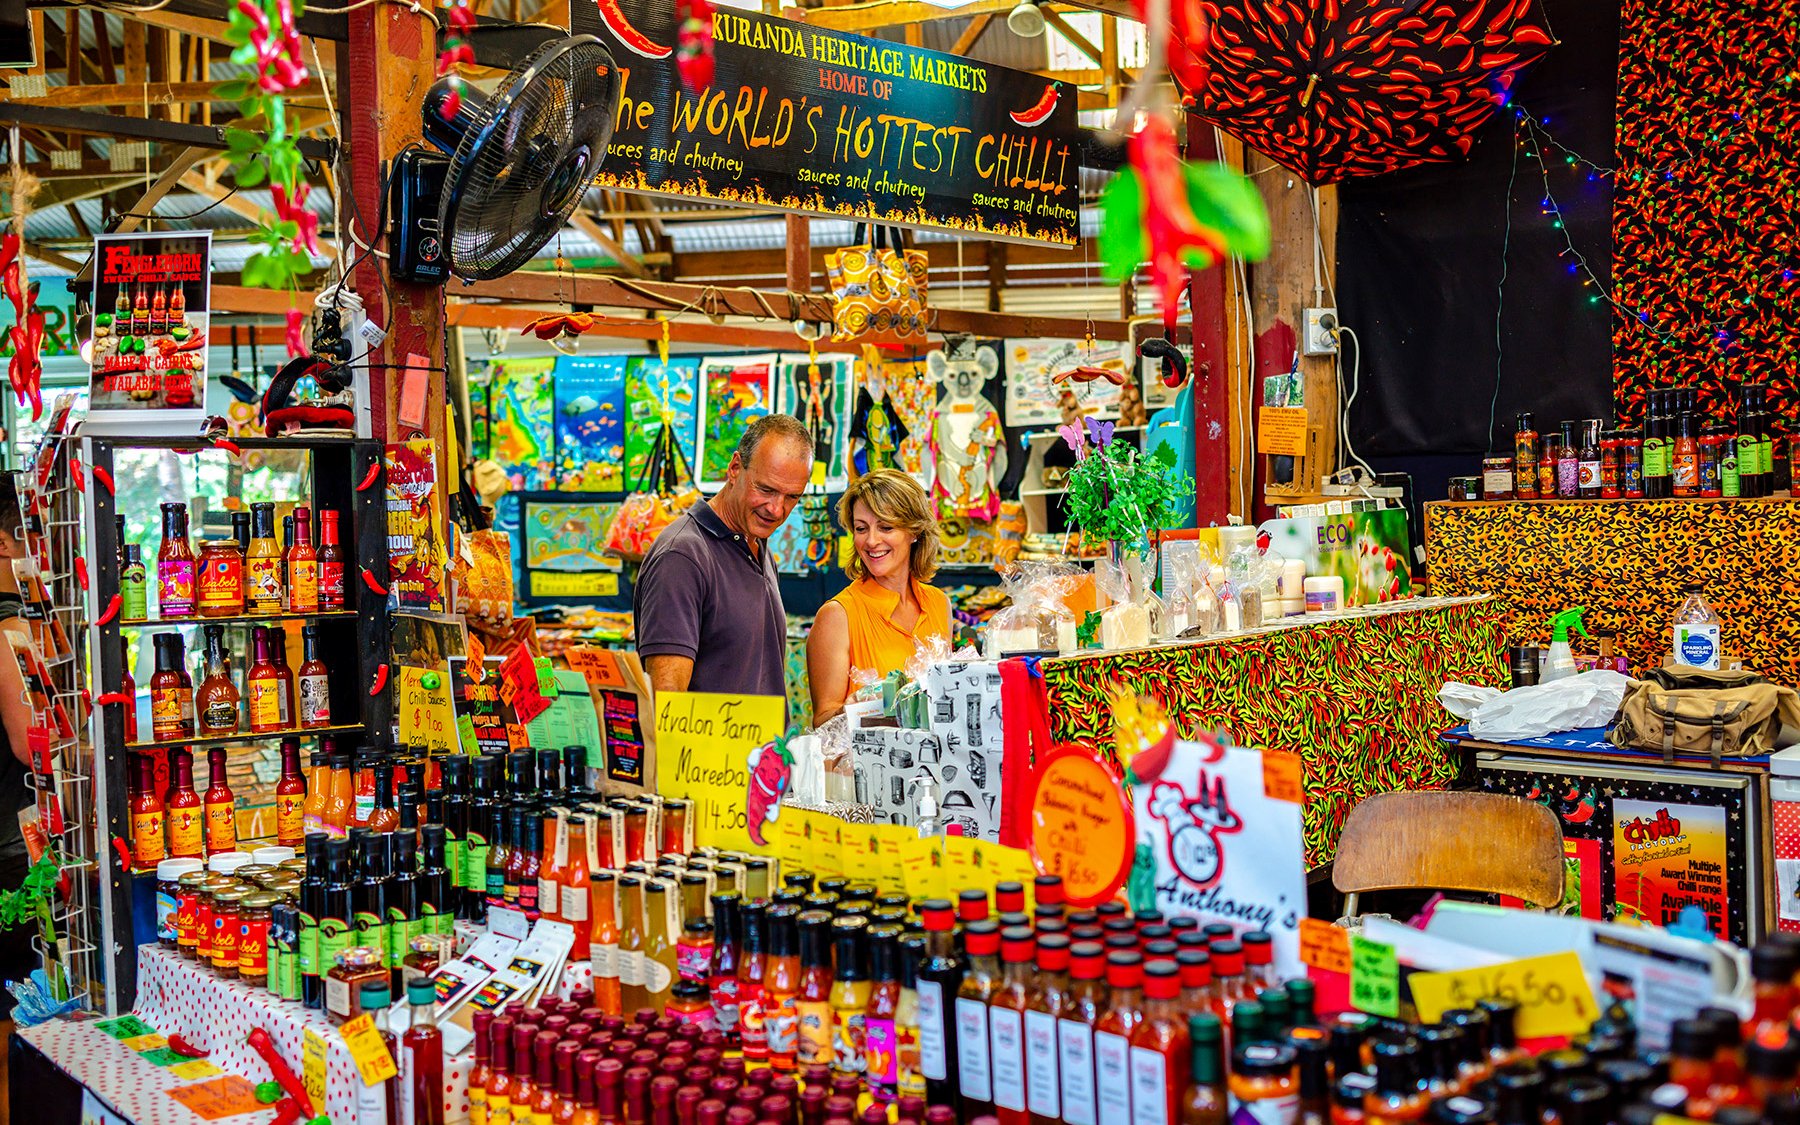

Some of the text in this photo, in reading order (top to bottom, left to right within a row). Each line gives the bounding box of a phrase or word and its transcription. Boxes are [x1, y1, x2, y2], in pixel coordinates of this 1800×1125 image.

[711, 11, 988, 94] KURANDA HERITAGE MARKETS
[819, 68, 893, 101] HOME OF
[613, 66, 1071, 196] he WORLD'S HOTTEST CHILLI
[607, 139, 745, 181] uces and chutney
[797, 166, 927, 205] sauces and chutney
[972, 190, 1078, 227] sauces and chutney
[103, 273, 202, 284] SWEET CHILLI SAUCE
[415, 264, 441, 274] ARLEC
[154, 353, 194, 371] CAIRNS
[102, 373, 193, 393] AVAILABLE HERE
[463, 683, 499, 702] BUSHFIRE
[657, 697, 713, 737] Avalon
[717, 699, 763, 745] Farm
[674, 744, 747, 789] Mareeba
[703, 797, 748, 831] 14.50
[1629, 835, 1683, 851] FACTORY
[1660, 868, 1722, 886] Award Winning
[1688, 860, 1722, 873] Multiple
[1677, 881, 1722, 896] Chilli range
[1155, 874, 1299, 932] Anthony's
[1661, 892, 1723, 915] Available
[177, 912, 195, 926] bels
[212, 932, 236, 946] bels
[239, 939, 261, 953] bels
[340, 1015, 370, 1039] SALE
